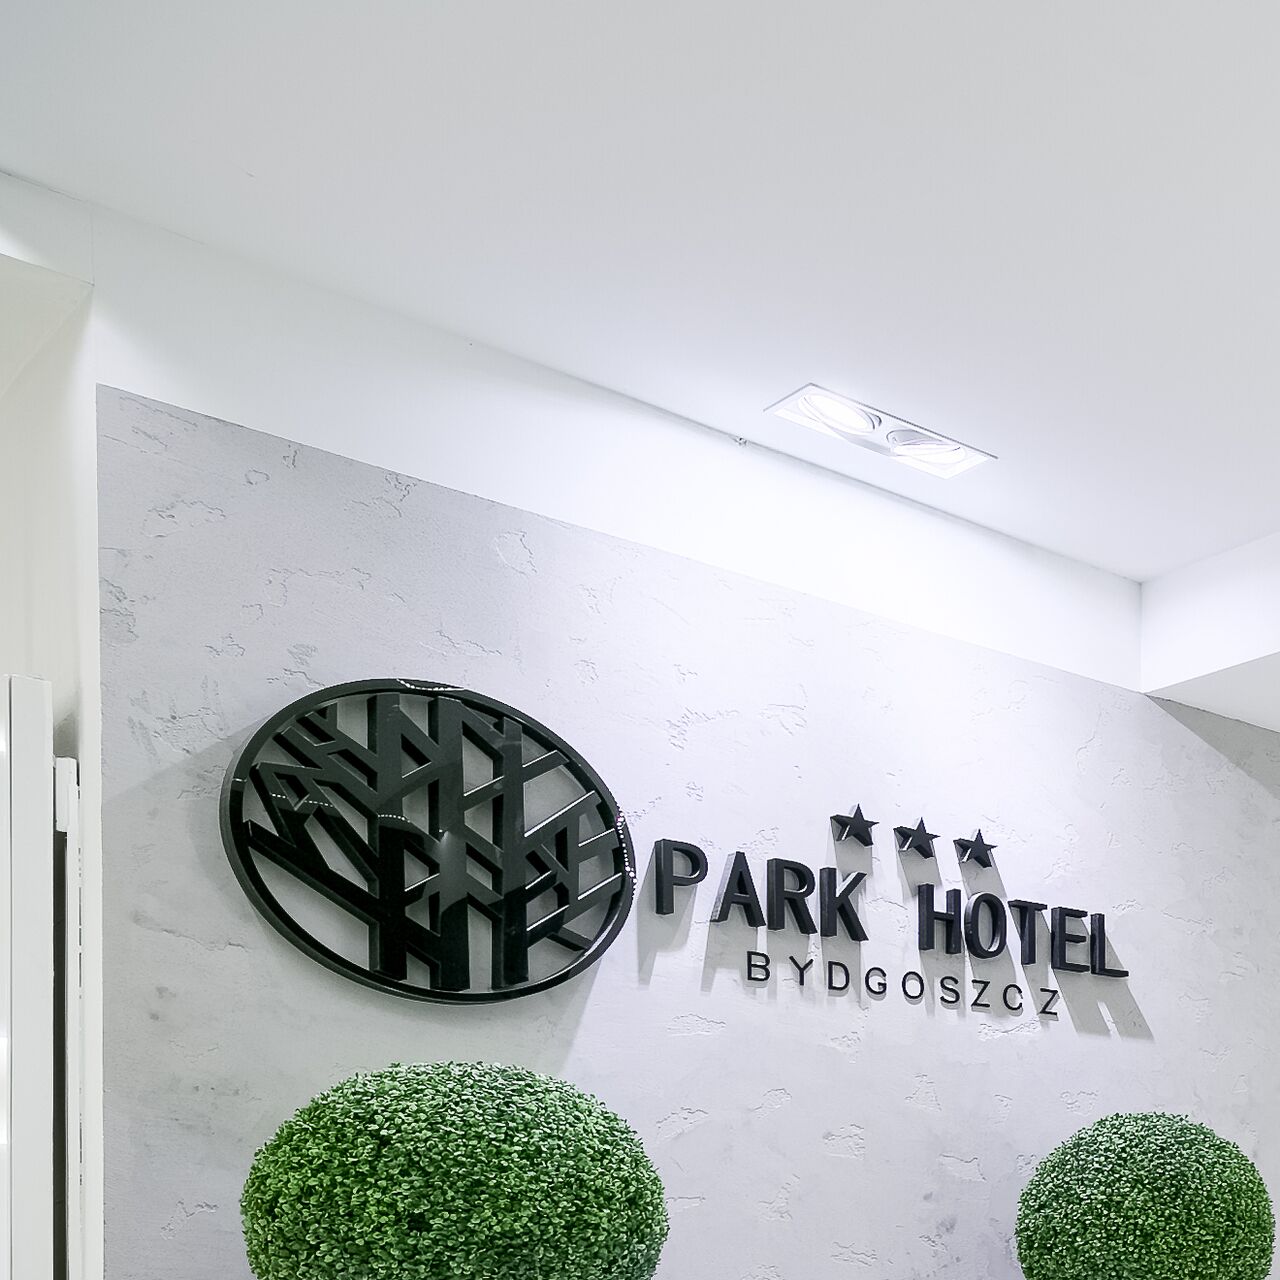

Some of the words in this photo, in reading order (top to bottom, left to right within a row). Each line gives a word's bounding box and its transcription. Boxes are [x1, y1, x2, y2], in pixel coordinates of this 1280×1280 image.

[654, 837, 870, 942] PARK
[916, 881, 1130, 978] HOTEL
[746, 949, 1059, 1017] BYDGOSZCZ
